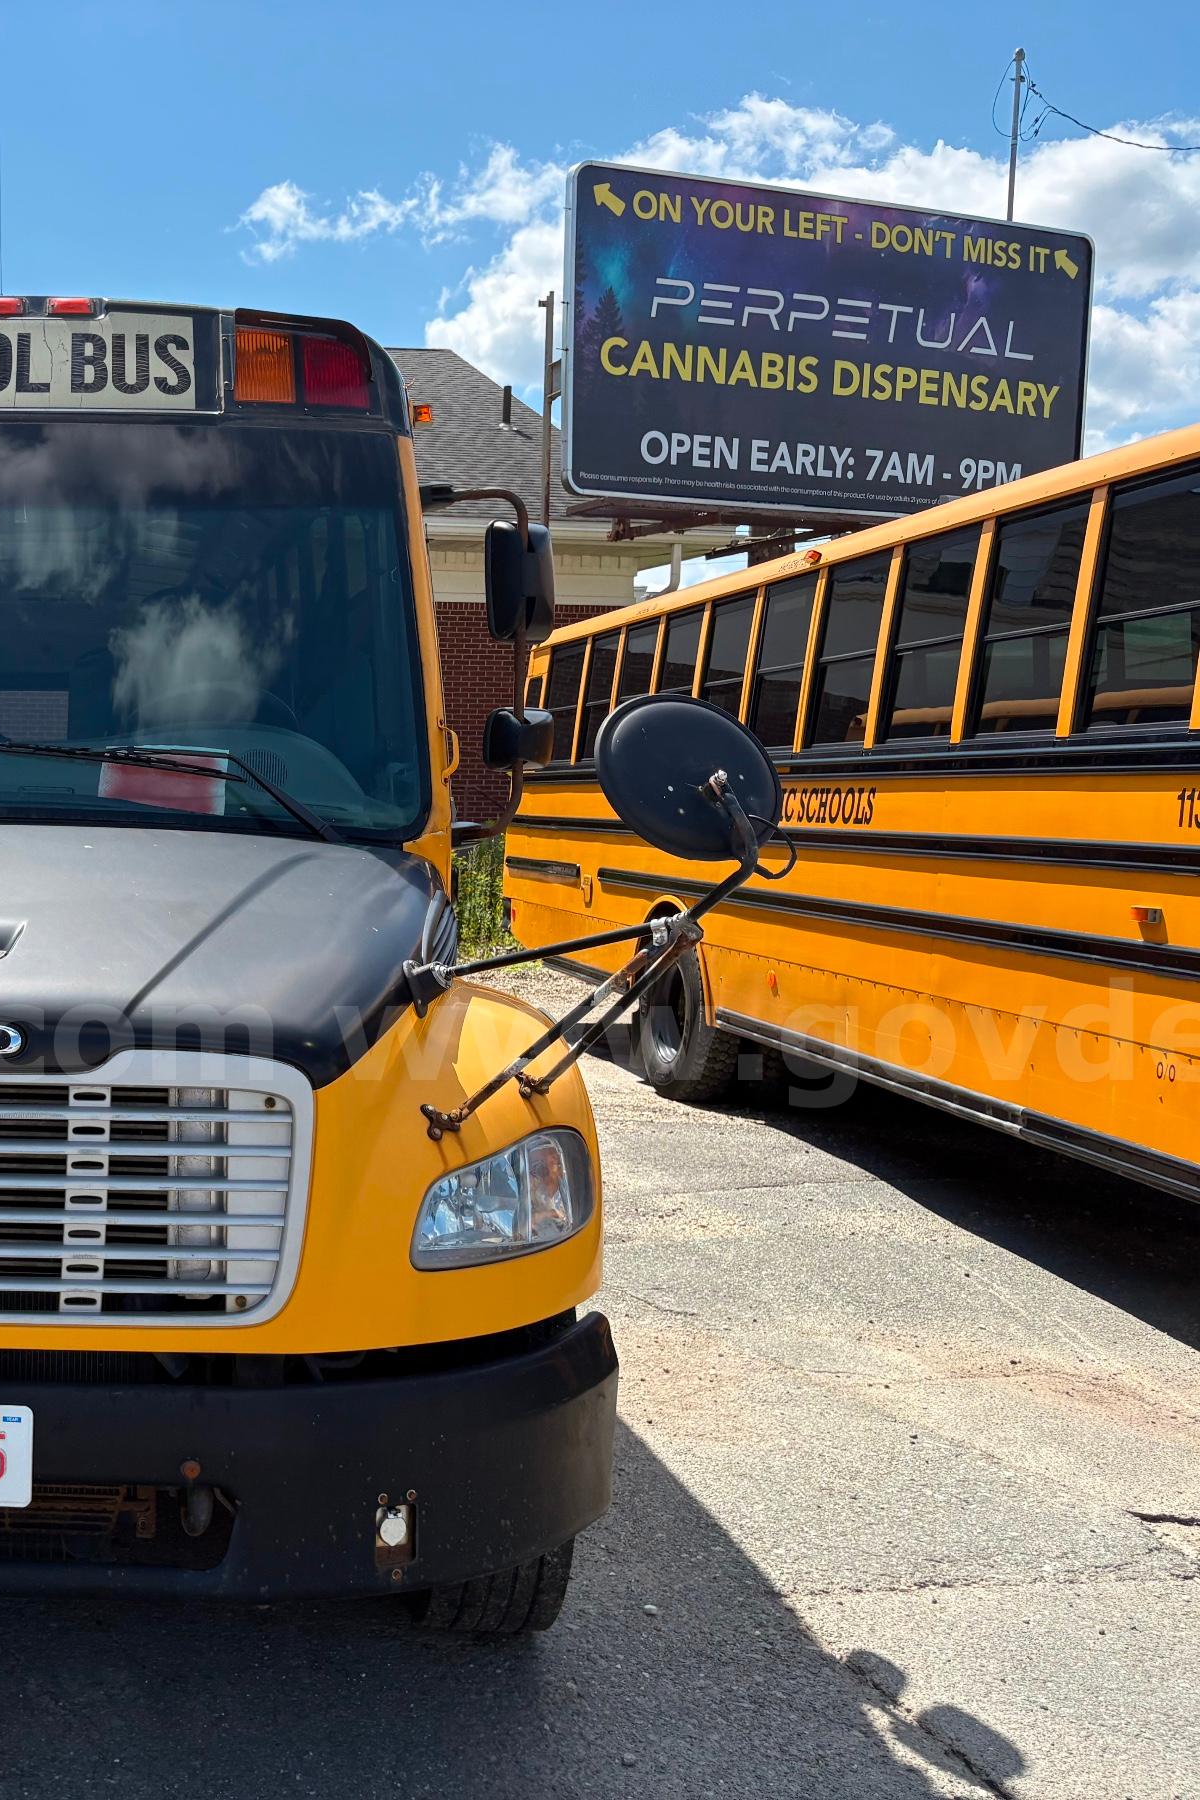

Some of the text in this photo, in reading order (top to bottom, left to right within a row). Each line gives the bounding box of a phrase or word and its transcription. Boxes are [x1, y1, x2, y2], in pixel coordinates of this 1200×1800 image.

[633, 190, 681, 223] ON
[690, 197, 774, 235] YOUR
[783, 209, 848, 244] LEFT
[871, 222, 956, 259] DON'T
[963, 235, 1021, 270] MISS
[1029, 245, 1050, 274] IT
[650, 277, 1034, 361] PERPETUAL
[70, 332, 192, 395] BUS
[600, 336, 1060, 419] CANNABIS DISPENSARY
[640, 430, 739, 470] OPEN
[750, 439, 856, 479] EARLY:
[865, 449, 935, 486] 7AM
[960, 457, 1022, 490] 9PM
[797, 786, 876, 825] SCHOOLS
